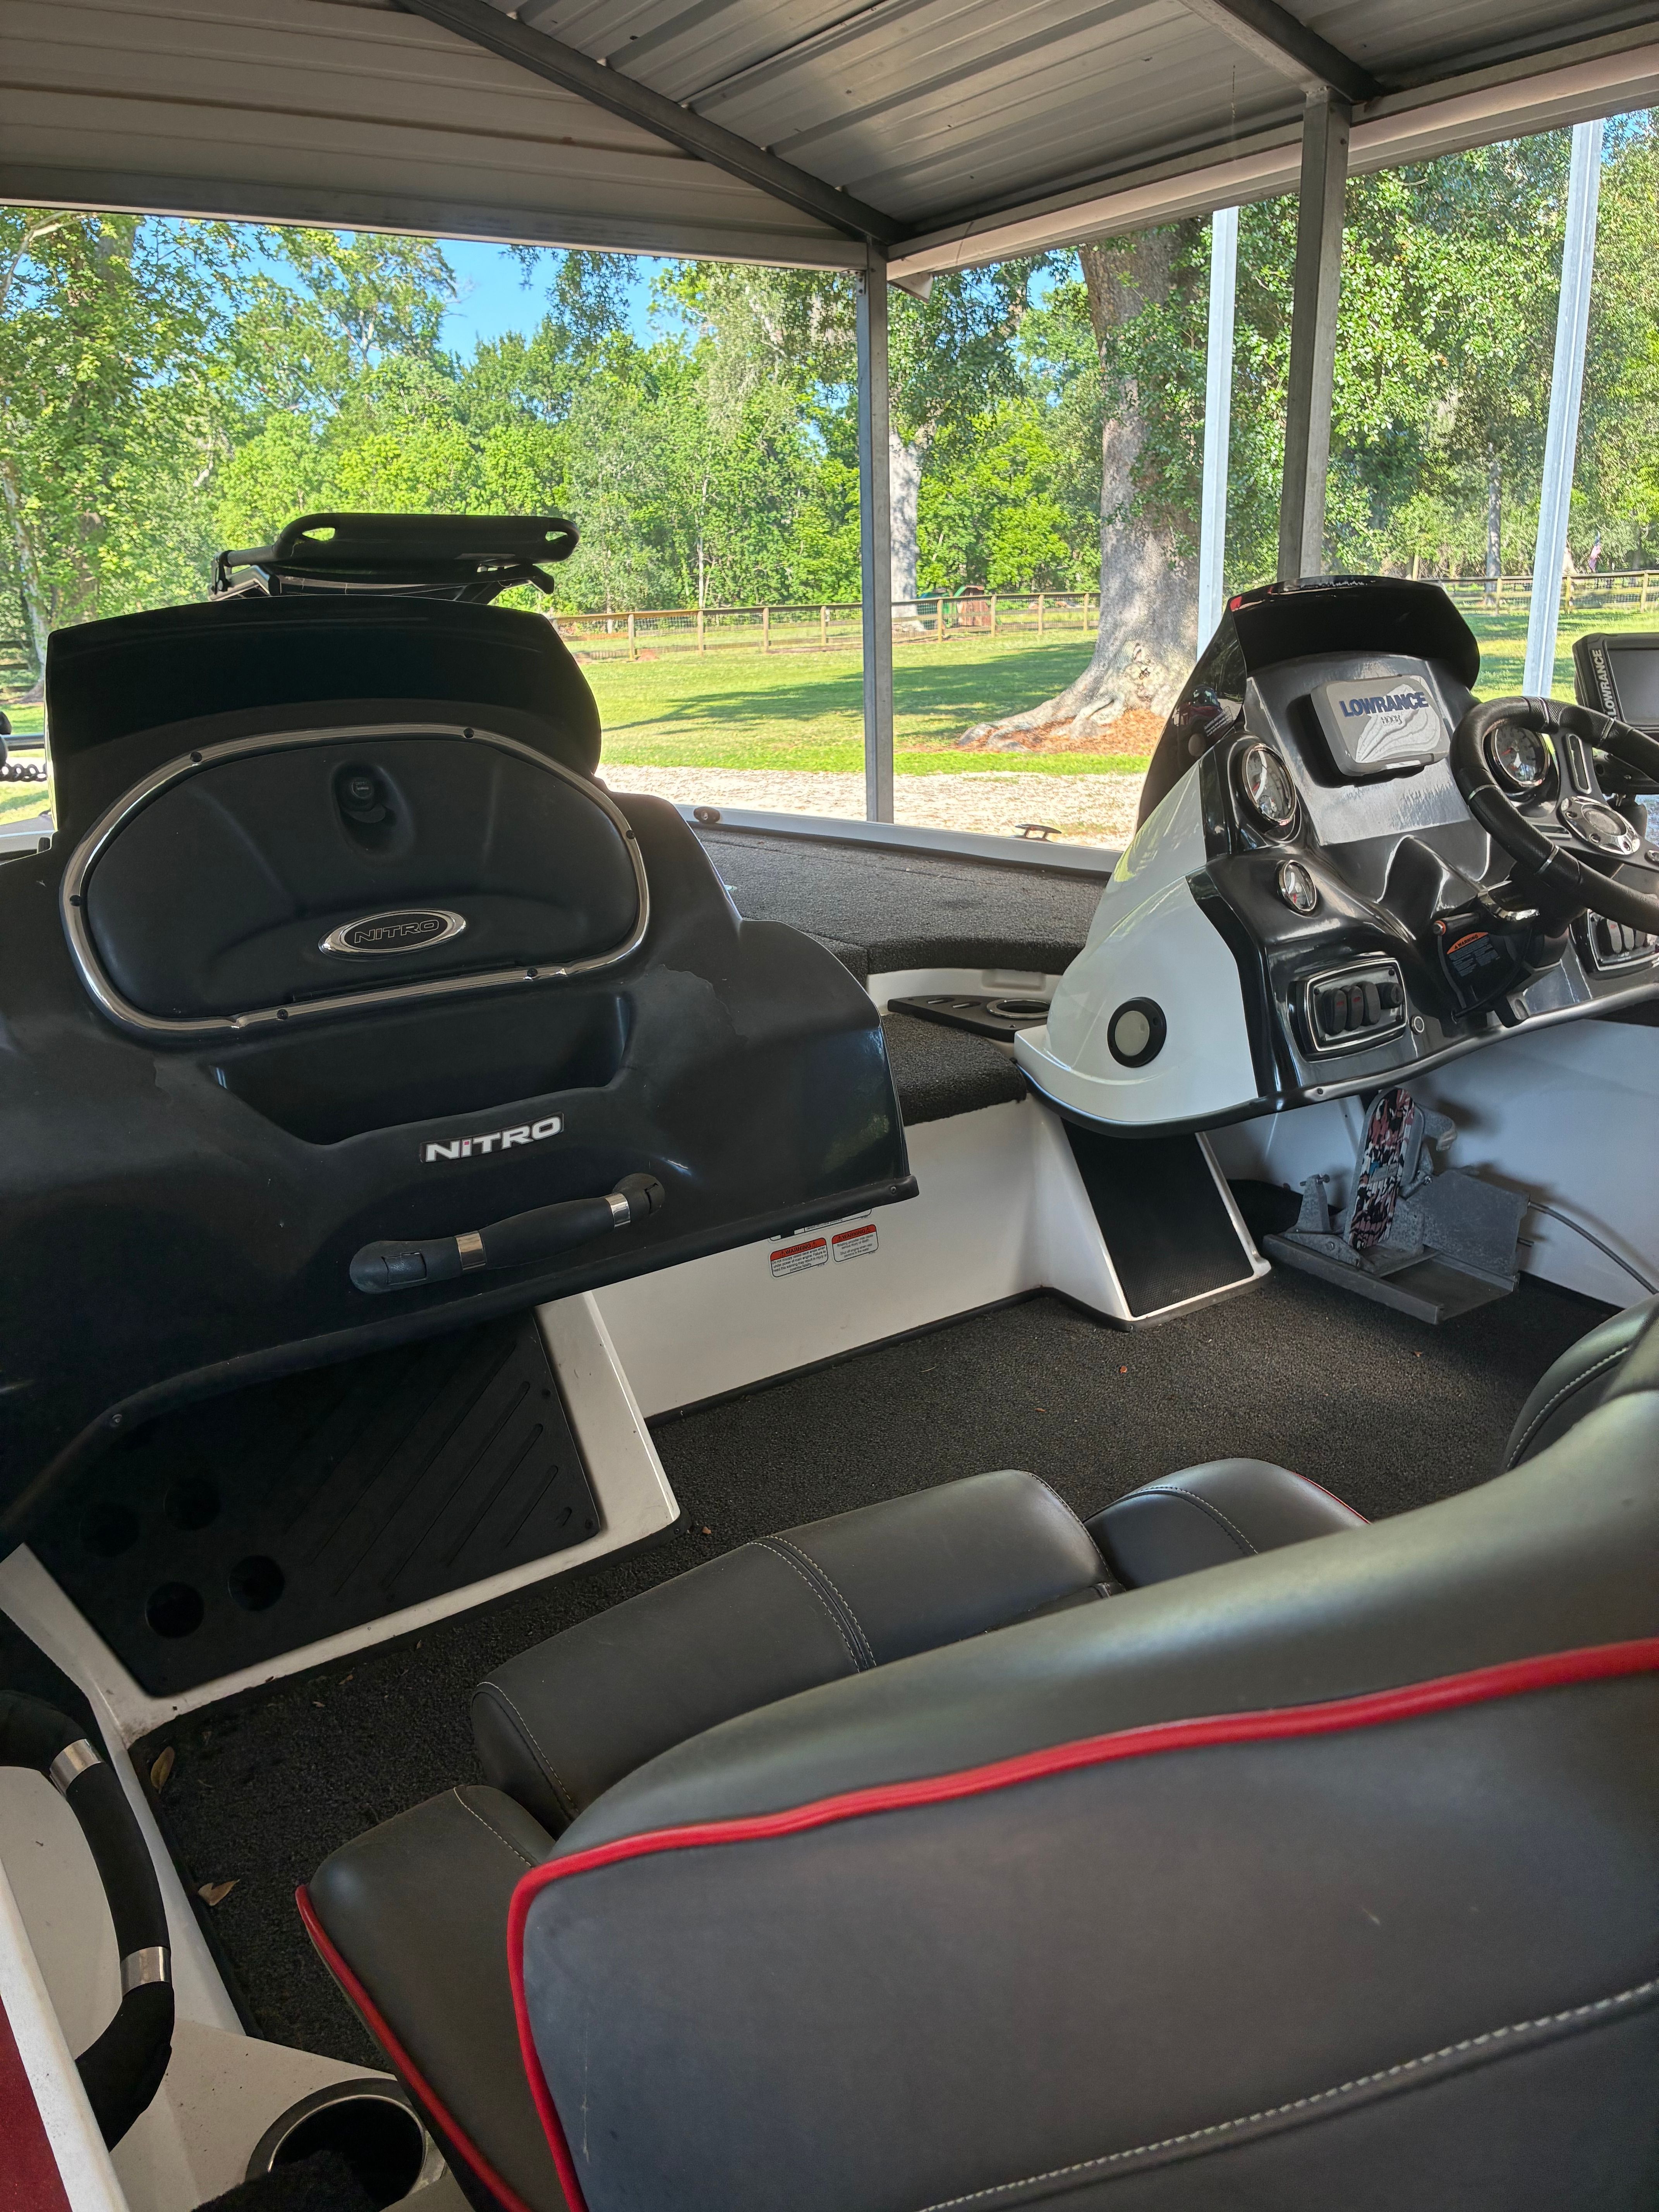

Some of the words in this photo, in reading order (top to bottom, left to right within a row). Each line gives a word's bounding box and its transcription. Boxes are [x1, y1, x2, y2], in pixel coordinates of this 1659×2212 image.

[1592, 649, 1617, 716] LOWRANCE
[1339, 691, 1429, 718] LOWRANCE
[354, 919, 439, 943] NITRO
[1458, 934, 1479, 947] WARNING
[785, 1243, 811, 1255] WARNING
